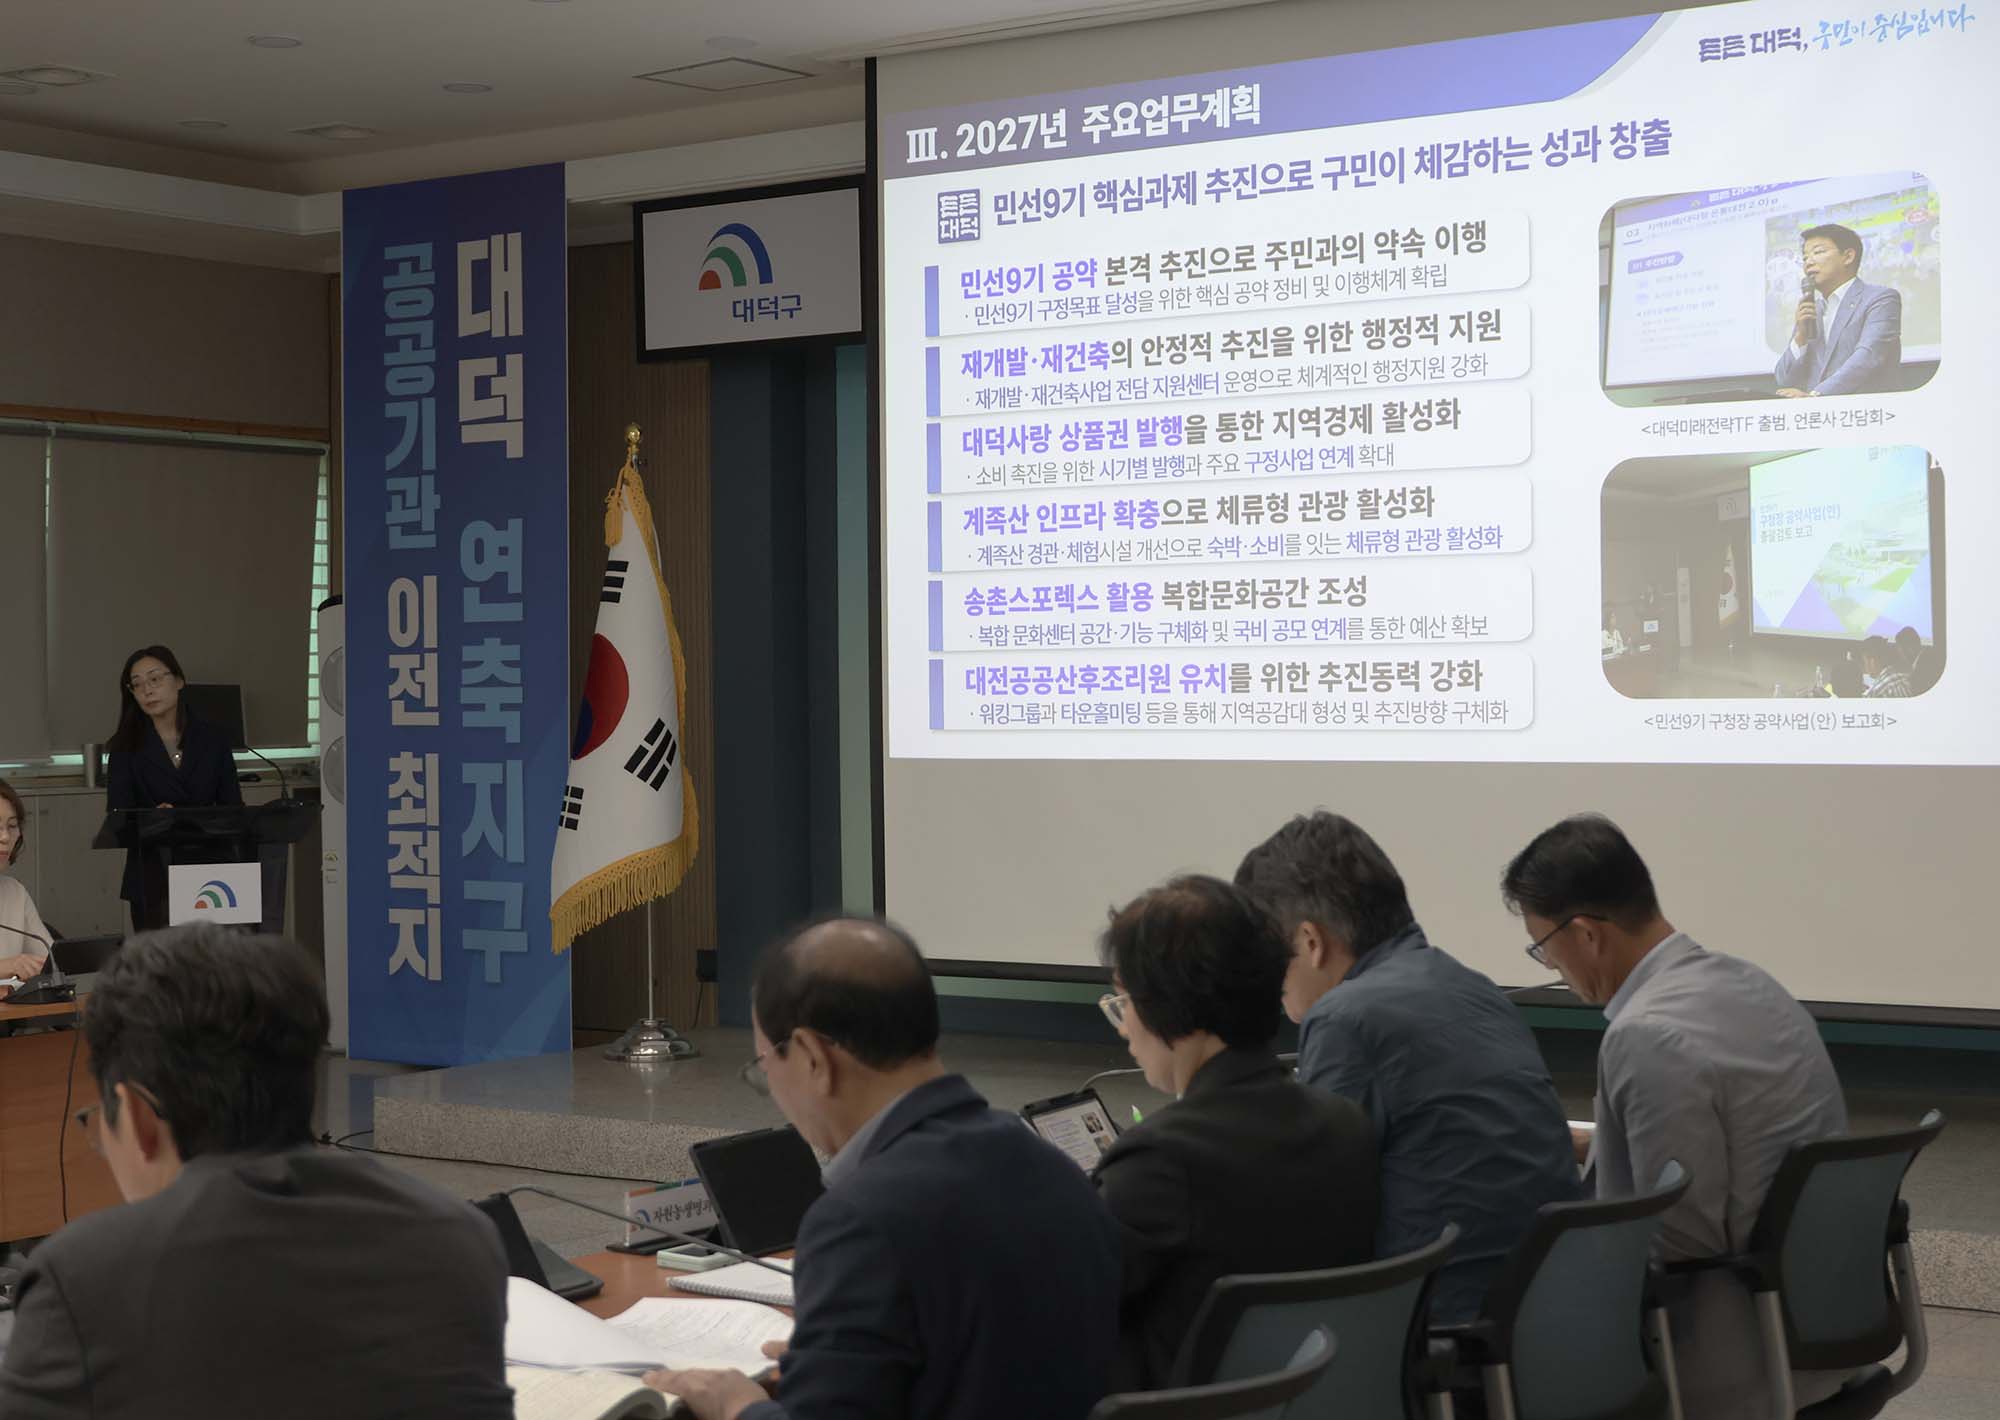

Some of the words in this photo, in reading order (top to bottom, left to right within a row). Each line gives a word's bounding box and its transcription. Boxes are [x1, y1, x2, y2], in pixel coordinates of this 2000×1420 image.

[956, 108, 1068, 157] 2027년
[1082, 83, 1261, 144] 주요업무계획
[993, 183, 1087, 226] 민선9기
[1093, 171, 1198, 214] 핵심과제
[1205, 160, 1314, 204] 추진으로
[1321, 146, 1406, 191] 구민이
[1414, 136, 1532, 180] 체감하는
[1540, 125, 1601, 168] 성과
[1609, 118, 1672, 159] 창출
[940, 217, 978, 239] 대덕
[961, 263, 1044, 299] 민선9기
[1052, 257, 1098, 292] 공약
[1105, 252, 1151, 286] 본격
[1159, 244, 1257, 281] 추진으로
[1264, 232, 1365, 271] 주민과의
[1374, 228, 1426, 258] 약속
[1435, 220, 1487, 255] 이행
[731, 293, 802, 323] 대덕구
[975, 299, 1033, 326] 민선9기
[1037, 295, 1101, 322] 구정목표
[1105, 289, 1154, 316] 달성을
[1158, 284, 1192, 311] 위한
[1195, 281, 1229, 307] 핵심
[1234, 278, 1269, 305] 공약
[1273, 275, 1307, 301] 정비
[1313, 273, 1330, 298] 및
[1335, 267, 1407, 295] 이행체계
[1411, 263, 1448, 289] 확립
[457, 231, 524, 459] 대덕
[961, 337, 1133, 380] 재개발·재건축의
[1141, 331, 1212, 367] 안정적
[1220, 326, 1295, 360] 추진을
[1303, 320, 1354, 354] 위한
[1361, 313, 1439, 350] 행정적
[1449, 308, 1501, 343] 지원
[383, 241, 441, 549] 공공기관
[1116, 376, 1149, 402] 전담
[1152, 371, 1219, 398] 지원센터
[1224, 368, 1293, 393] 운영으로
[1297, 361, 1368, 388] 체계적인
[1372, 356, 1445, 383] 행정지원
[1451, 352, 1488, 378] 강화
[962, 423, 1052, 457] 대덕사랑
[1059, 418, 1128, 452] 상품권
[1136, 413, 1208, 448] 발행을
[1215, 409, 1264, 443] 통한
[1273, 402, 1373, 439] 지역경제
[1382, 397, 1461, 434] 활성화
[1794, 411, 1837, 430] 언론사
[976, 463, 1006, 487] 소비
[1010, 461, 1058, 485] 촉진을
[1062, 459, 1095, 483] 위한
[1099, 455, 1148, 481] 시기별
[1152, 453, 1202, 480] 발행과
[1205, 452, 1241, 475] 주요
[1244, 447, 1314, 474] 구정사업
[1318, 444, 1354, 470] 연계
[1359, 442, 1394, 467] 확대
[963, 503, 1029, 536] 계족산
[1036, 500, 1106, 534] 인프라
[1113, 497, 1209, 530] 확충으로
[1216, 491, 1289, 526] 체류형
[1298, 488, 1348, 523] 관광
[1356, 485, 1435, 521] 활성화
[977, 543, 1024, 567] 계족산
[1136, 538, 1202, 562] 개선으로
[1306, 532, 1342, 556] 잇는
[1346, 528, 1400, 554] 체류형
[1405, 526, 1442, 552] 관광
[1446, 524, 1503, 550] 활성화
[964, 584, 1098, 616] 송촌스포렉스
[1106, 581, 1154, 613] 활용
[1162, 577, 1309, 611] 복합문화공간
[1316, 575, 1368, 608] 조성
[387, 575, 440, 727] 이전
[978, 624, 1009, 647] 복합
[1013, 622, 1075, 646] 문화센터
[1157, 620, 1208, 644] 구체화
[1212, 620, 1229, 644] 및
[1233, 618, 1267, 642] 국비
[1271, 618, 1308, 642] 공모
[1311, 616, 1365, 642] 연계를
[1369, 615, 1406, 640] 통한
[1409, 615, 1447, 639] 예산
[1451, 614, 1488, 638] 확보
[966, 662, 1171, 695] 대전공공산후조리원
[1178, 662, 1252, 694] 유치를
[1260, 661, 1310, 693] 위한
[1318, 660, 1420, 692] 추진동력
[1429, 659, 1483, 692] 강화
[980, 702, 1057, 725] 워킹그룹과
[1061, 701, 1141, 725] 타운홀미팅
[1145, 702, 1178, 724] 등을
[1183, 700, 1216, 725] 통해
[1221, 700, 1307, 724] 지역공감대
[1312, 700, 1346, 724] 형성
[1352, 700, 1369, 724] 및
[1374, 700, 1448, 724] 추진방향
[1451, 700, 1509, 724] 구체화
[1709, 713, 1750, 730] 구청장
[1753, 712, 1837, 731] 공약사업(안)
[460, 518, 528, 983] 연축지구
[387, 751, 443, 981] 최적지
